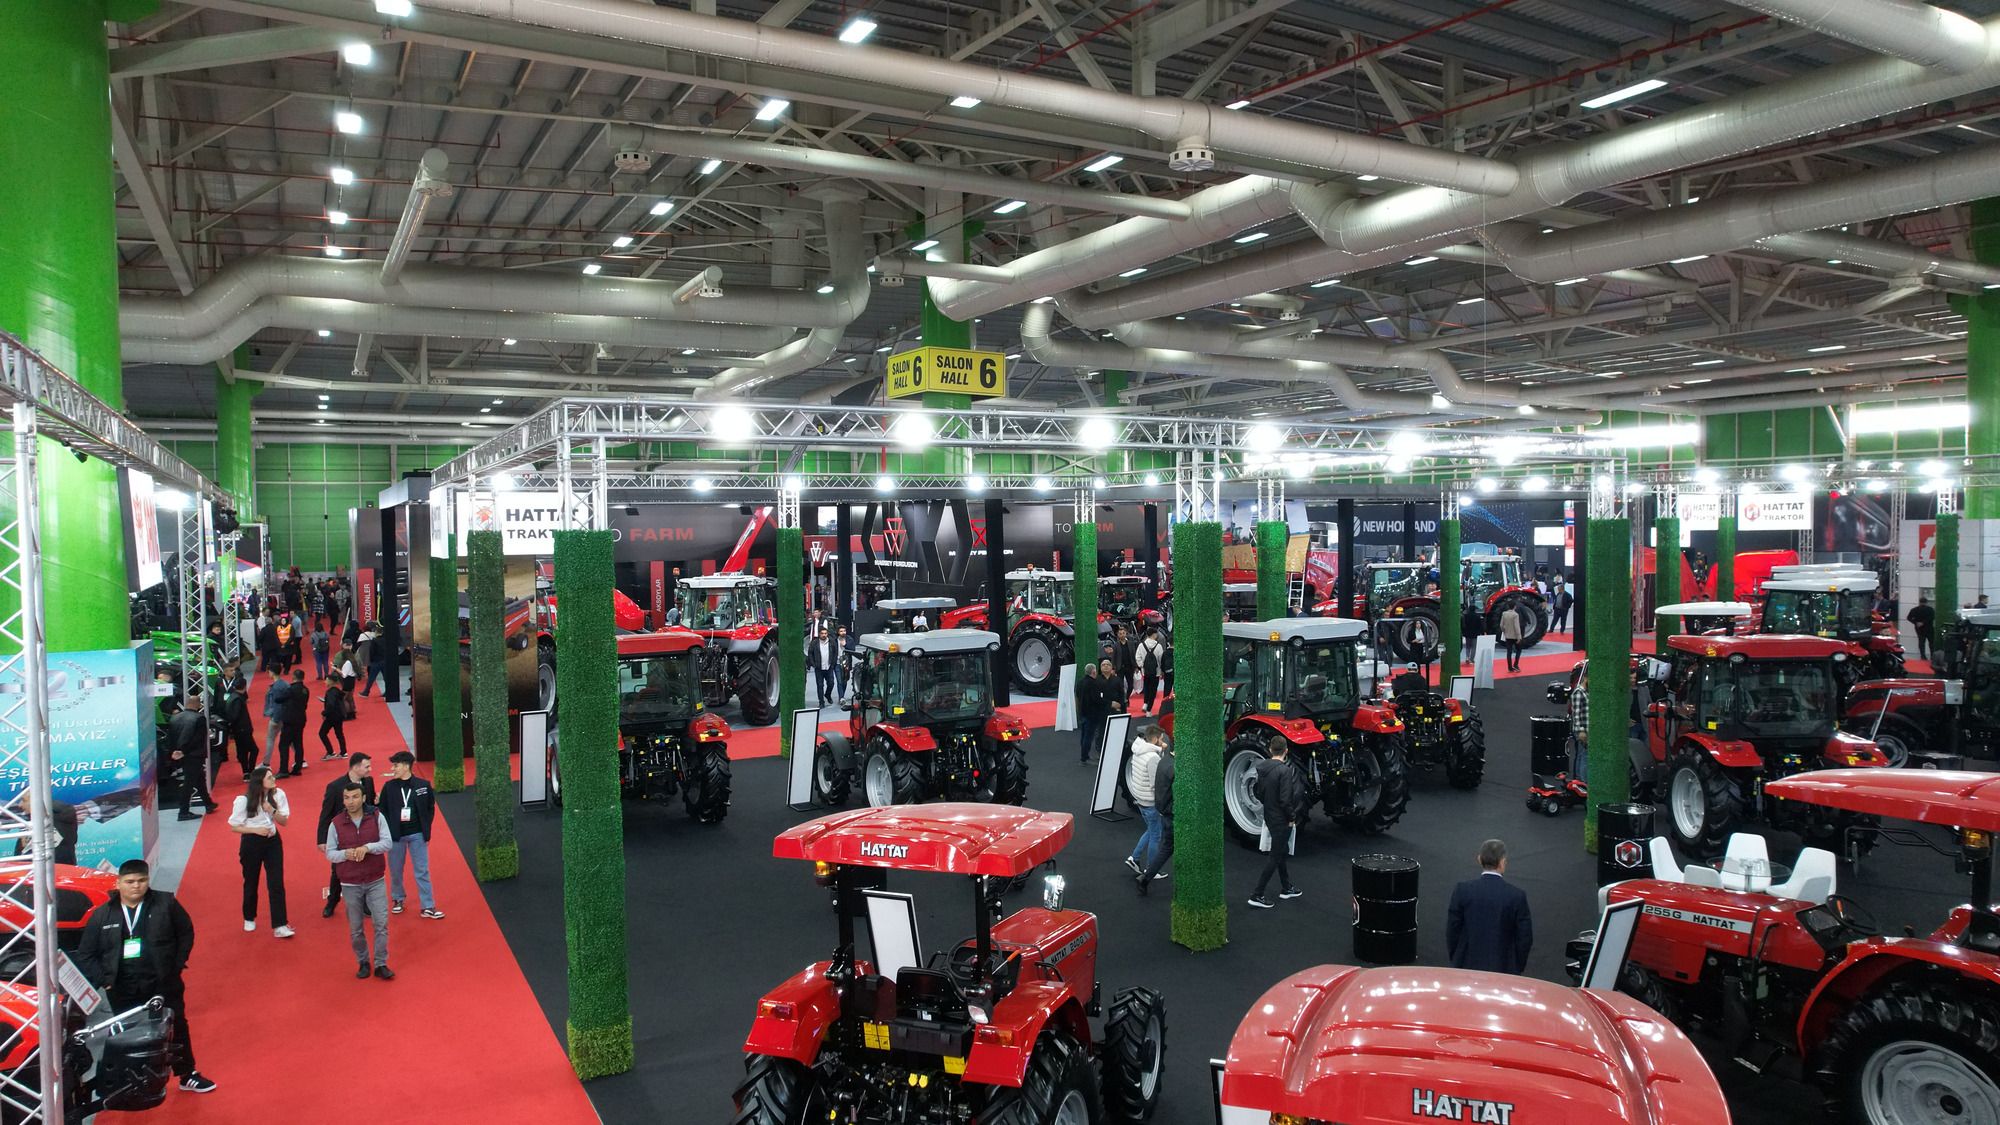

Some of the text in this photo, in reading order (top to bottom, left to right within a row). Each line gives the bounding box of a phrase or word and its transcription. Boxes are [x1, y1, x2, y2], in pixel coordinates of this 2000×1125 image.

[892, 359, 911, 375] SALON
[936, 354, 973, 370] SALON
[913, 355, 923, 387] 6
[940, 371, 969, 386] HALL
[979, 358, 997, 389] 6
[893, 377, 909, 390] HALL
[1763, 502, 1805, 511] HATTAT
[1055, 523, 1072, 533] TO
[1363, 520, 1436, 533] NEW HOAND
[629, 527, 694, 542] FARM
[875, 559, 918, 568] MASSEY FERGUSON
[861, 840, 909, 859] HATTAT
[1693, 914, 1736, 930] HATTAT
[1412, 1087, 1514, 1125] HATTAT
